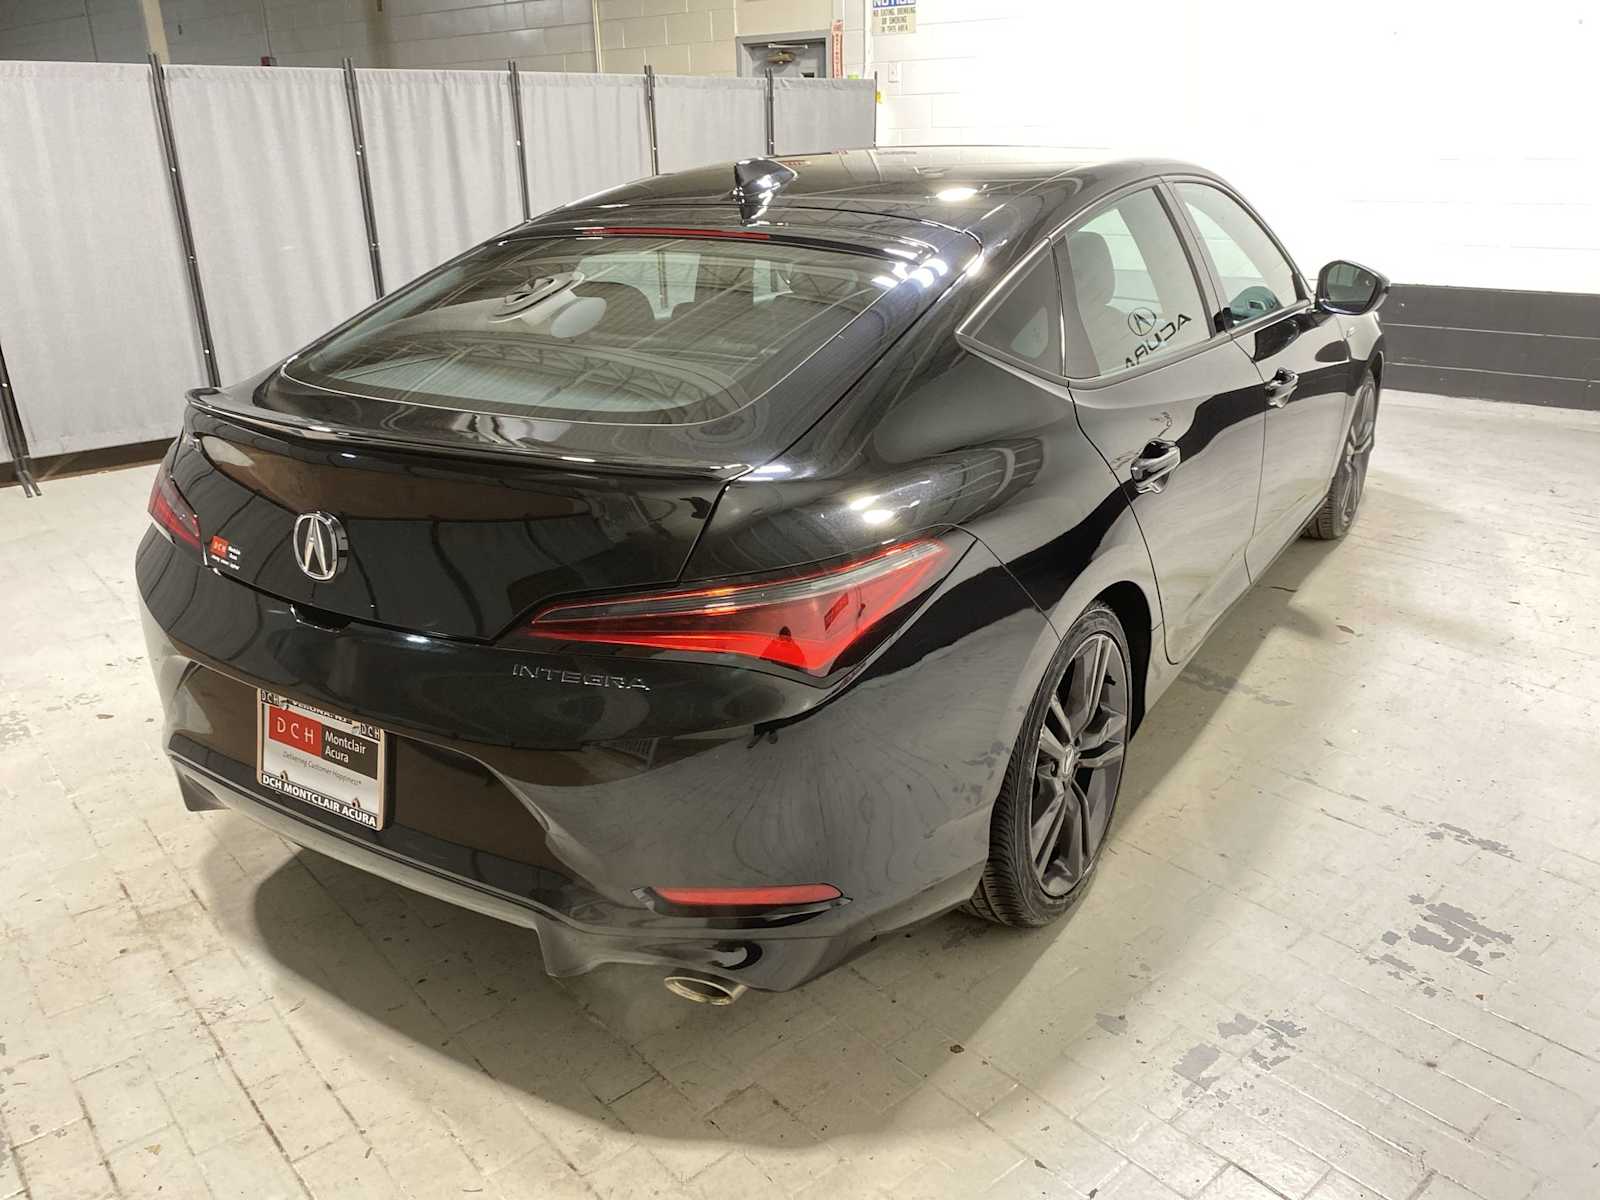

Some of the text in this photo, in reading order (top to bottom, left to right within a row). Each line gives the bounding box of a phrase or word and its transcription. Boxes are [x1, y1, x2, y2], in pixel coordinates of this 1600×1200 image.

[512, 664, 650, 691] INTEGRA
[261, 690, 280, 705] DCH
[276, 716, 314, 745] DCH
[325, 730, 367, 754] Montclair
[361, 723, 380, 739] DCH
[325, 745, 349, 763] Acura
[262, 774, 376, 827] DCH MONTCLAIR ACURA
